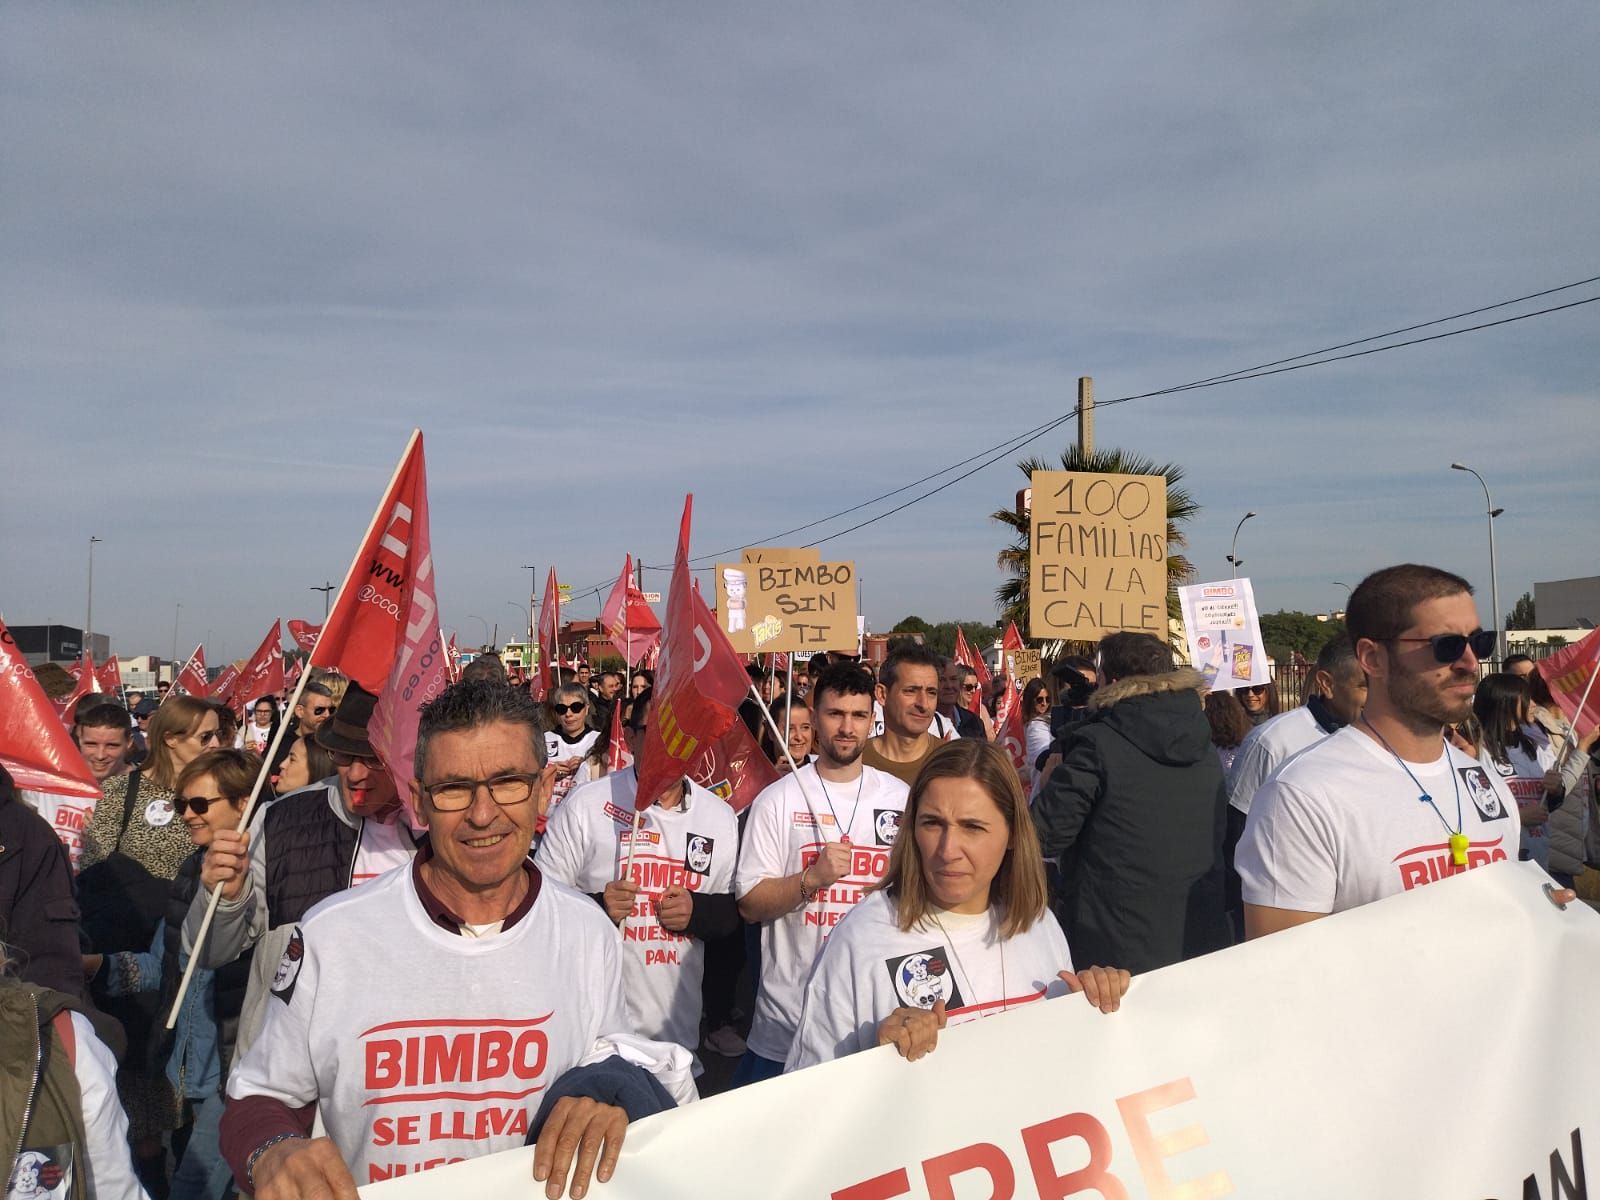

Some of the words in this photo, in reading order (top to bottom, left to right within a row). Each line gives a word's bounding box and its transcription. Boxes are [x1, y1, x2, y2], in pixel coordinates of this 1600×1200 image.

[1053, 478, 1150, 520] 100
[759, 565, 850, 592] BIMBO
[1041, 564, 1087, 592] EN
[1105, 567, 1146, 595] LA
[776, 591, 836, 614] SIN
[1044, 600, 1160, 630] CALLE
[751, 617, 783, 648] Takis
[790, 623, 831, 644] TI
[1508, 781, 1545, 796] BIMB
[55, 808, 83, 829] BIM
[621, 832, 650, 842] COO
[801, 851, 889, 878] BBO
[645, 949, 680, 965] PAN.
[364, 1029, 548, 1090] BIMBO
[373, 1116, 421, 1146] SE
[429, 1107, 528, 1141] LLEVA
